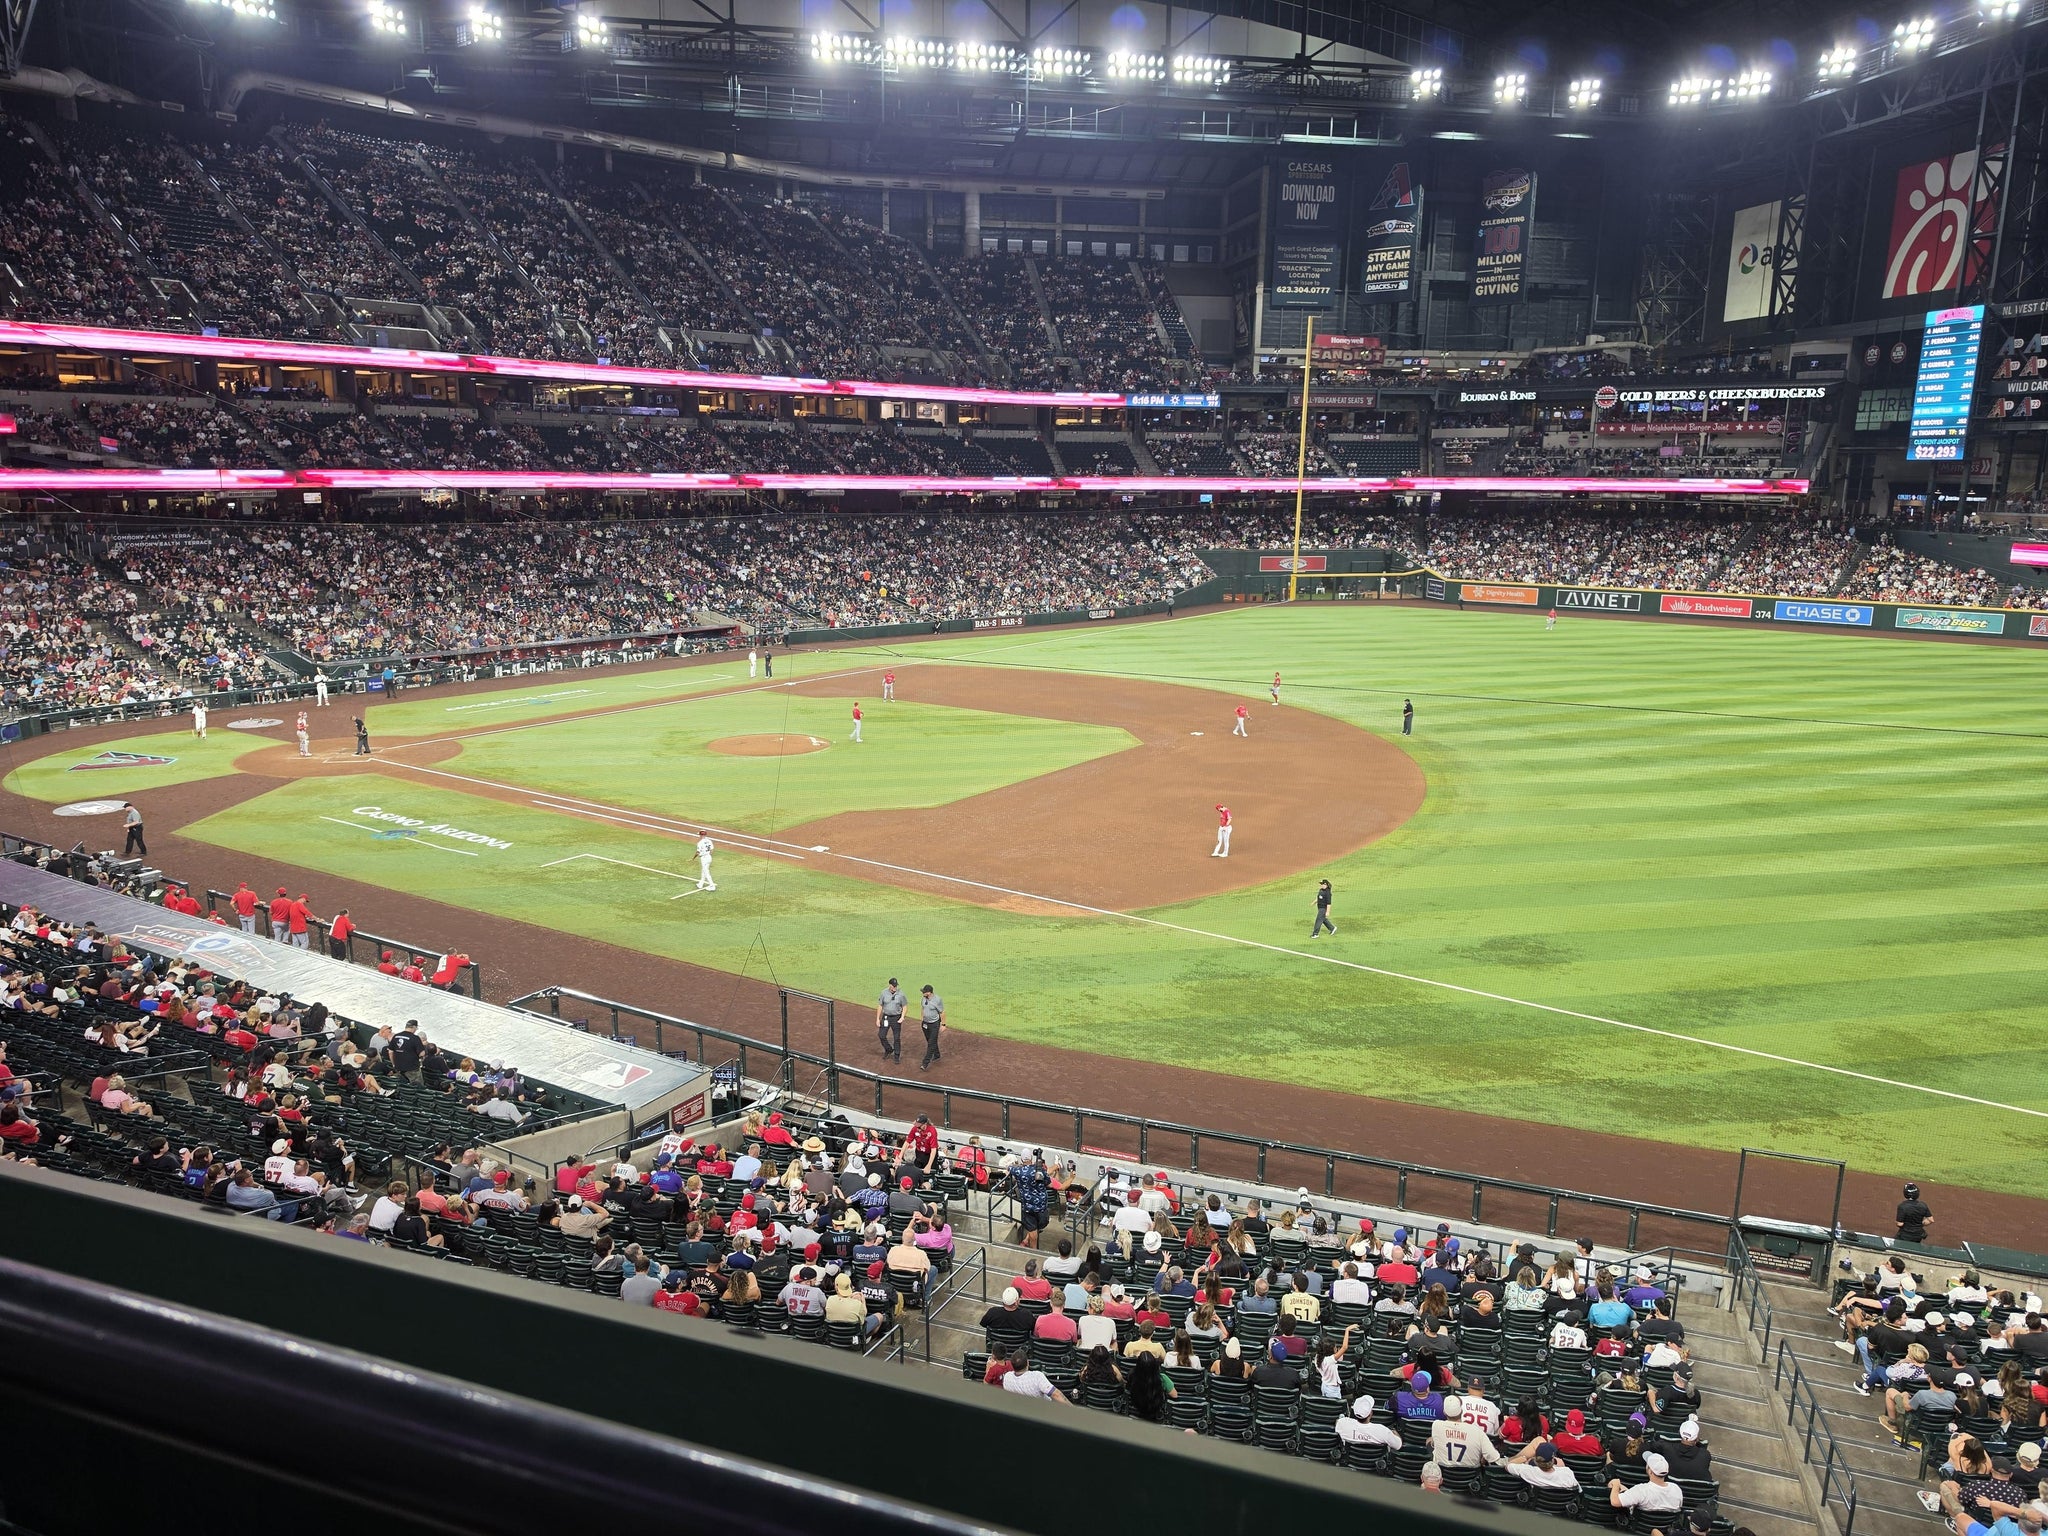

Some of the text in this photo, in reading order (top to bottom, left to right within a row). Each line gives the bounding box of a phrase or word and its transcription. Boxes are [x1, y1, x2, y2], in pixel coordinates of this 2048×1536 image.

[1288, 162, 1332, 173] CAESARS
[1282, 184, 1335, 202] DOWNLOAD
[1296, 203, 1319, 220] NOW
[1481, 216, 1525, 226] CELEBRATING
[1367, 249, 1411, 263] STREAM
[1477, 253, 1521, 266] MILLION
[1366, 261, 1410, 272] ANY GAME
[1494, 266, 1502, 274] IN
[1366, 270, 1409, 282] ANYWHERE
[1476, 274, 1520, 284] CHARITABLE
[1475, 283, 1519, 296] GIVING
[1312, 350, 1382, 361] SANDLOT
[2007, 381, 2029, 393] WILD
[1150, 396, 1164, 404] PM
[1347, 396, 1364, 404] SEATS
[1500, 391, 1508, 400] &
[1620, 392, 1652, 401] COLD
[1654, 390, 1697, 400] BEERS
[1698, 390, 1707, 400] &
[1708, 388, 1826, 400] CHEESEBURGERS
[1858, 397, 1908, 412] ULTRA
[1631, 423, 1730, 432] Your Neighborhood Burger Joint
[1914, 445, 1956, 458] $22,293
[1486, 589, 1506, 598] Dignity
[1564, 592, 1632, 608] AVNET
[1694, 603, 1744, 614] Budweiser
[1786, 606, 1842, 620] CHASE
[1755, 610, 1772, 619] 374
[975, 620, 997, 628] BAR-S
[1001, 618, 1022, 626] BAR-S
[1922, 616, 1950, 626] Baja
[1950, 617, 1988, 628] Blast
[352, 806, 514, 850] CASINO ARIZONA
[147, 928, 196, 942] CHASE
[222, 949, 260, 966] FIELD
[662, 1144, 678, 1154] 27
[268, 1160, 284, 1169] TROUT
[266, 1170, 282, 1183] 27
[832, 1236, 852, 1244] MARTE
[792, 1288, 810, 1298] TROUT
[861, 1287, 887, 1296] STAR
[788, 1298, 810, 1314] 27
[1290, 1298, 1313, 1306] JOHNSON
[1294, 1308, 1309, 1320] 51
[1559, 1336, 1575, 1347] 22
[1407, 1408, 1436, 1418] CARROLL
[1466, 1402, 1488, 1414] GLAUS
[1463, 1412, 1488, 1432] 25
[1446, 1430, 1468, 1440] OHTANI
[1446, 1442, 1468, 1462] 17
